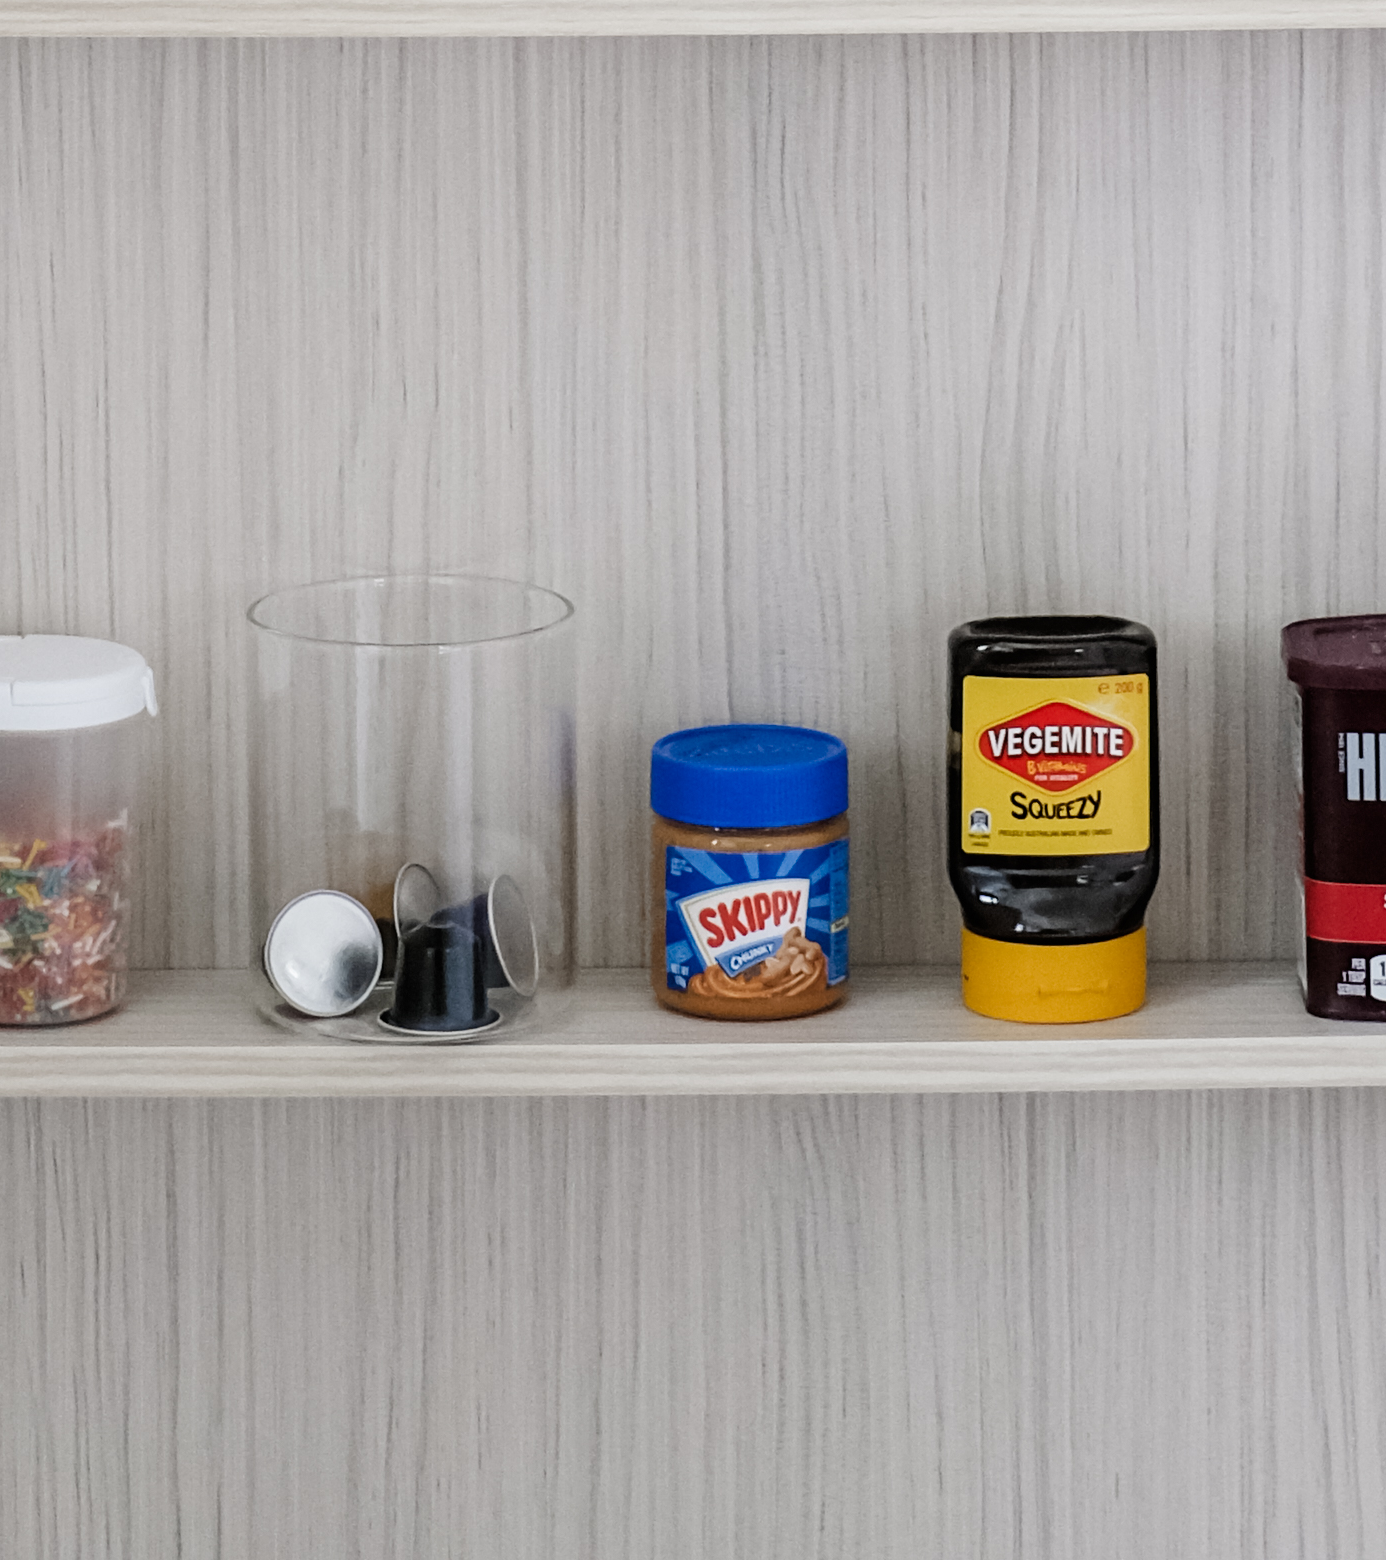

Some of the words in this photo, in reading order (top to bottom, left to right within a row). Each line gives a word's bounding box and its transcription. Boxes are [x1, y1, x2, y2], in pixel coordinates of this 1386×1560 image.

[1115, 681, 1134, 694] 200
[1136, 682, 1144, 694] g
[988, 725, 1125, 758] VEGEMITE
[1027, 760, 1037, 775] B
[698, 890, 801, 949] SKIPPY
[730, 942, 775, 971] CHUNKY
